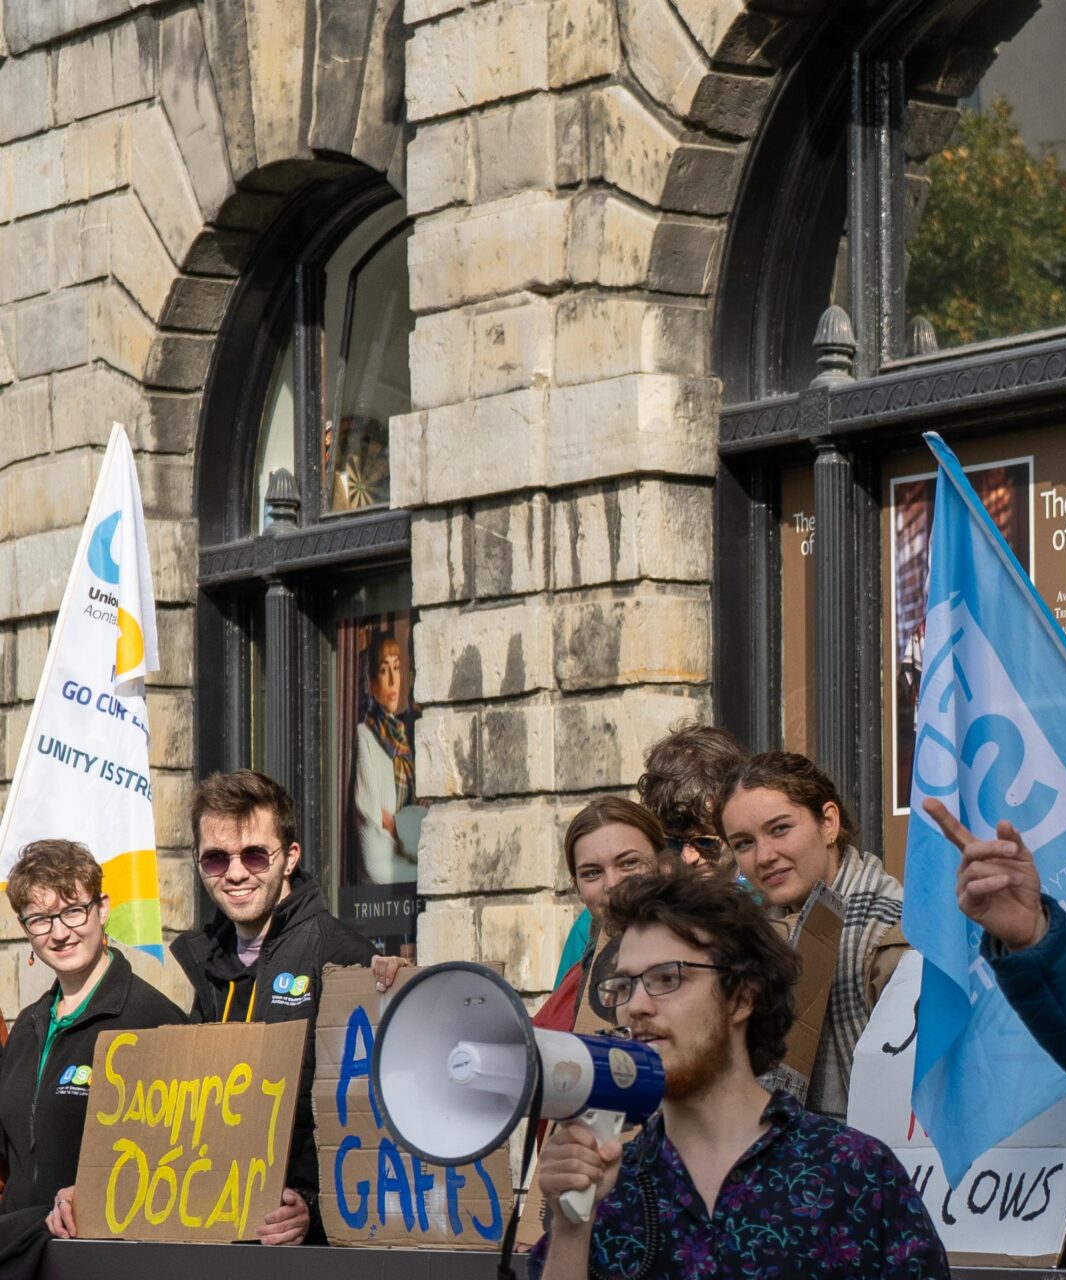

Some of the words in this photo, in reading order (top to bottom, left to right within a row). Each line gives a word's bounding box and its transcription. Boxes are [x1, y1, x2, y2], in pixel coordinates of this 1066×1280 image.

[793, 512, 816, 533] The
[801, 532, 816, 555] of
[62, 680, 93, 706] GO
[37, 734, 98, 773] UNITY
[100, 760, 115, 781] IS
[354, 901, 400, 919] TRINITY
